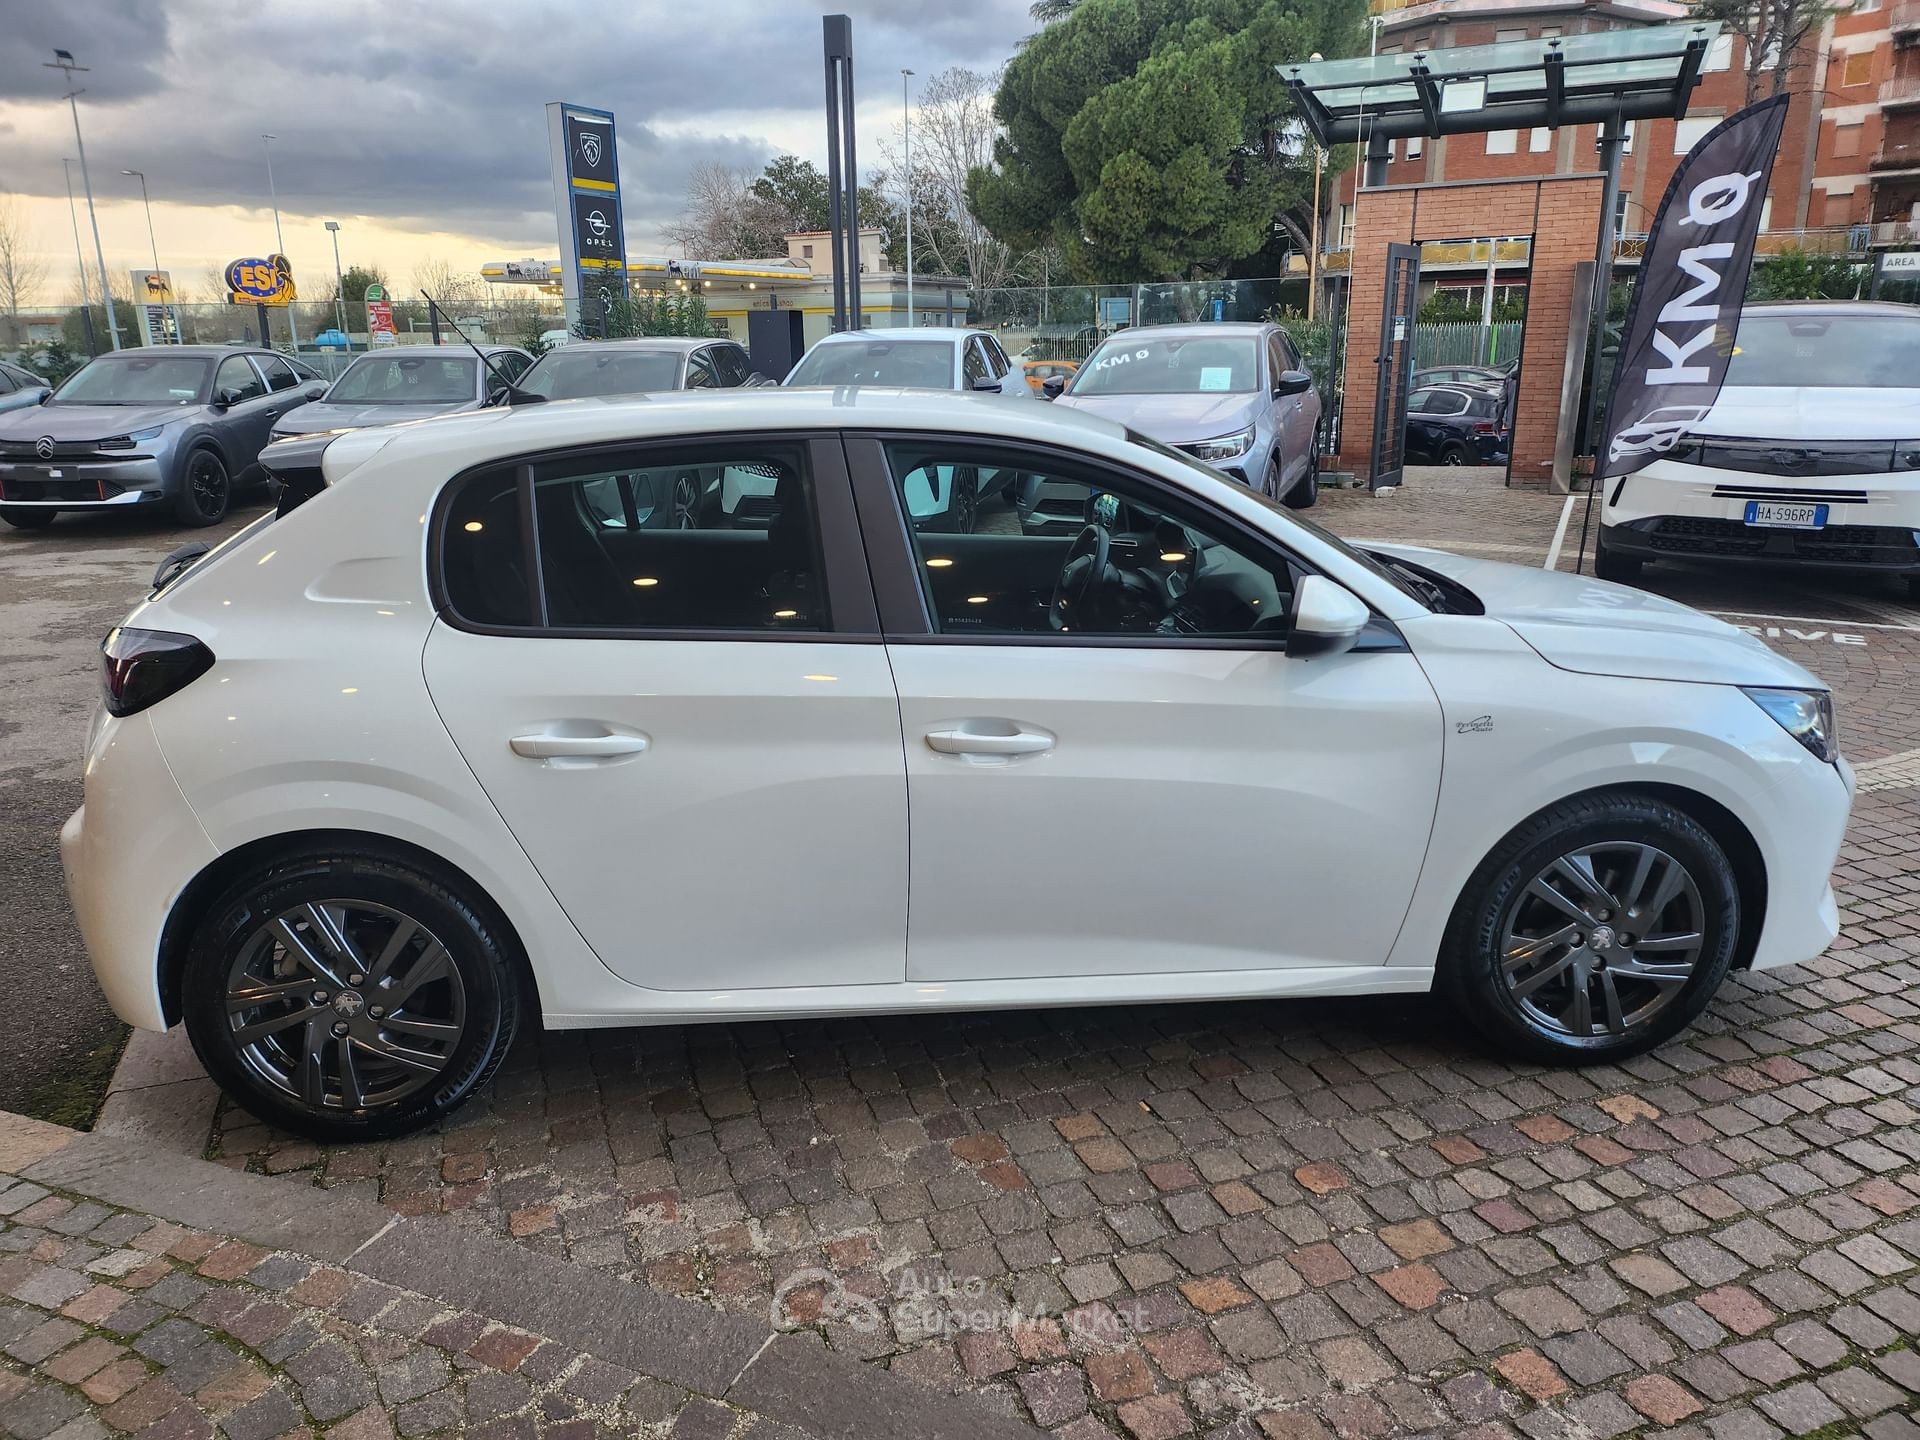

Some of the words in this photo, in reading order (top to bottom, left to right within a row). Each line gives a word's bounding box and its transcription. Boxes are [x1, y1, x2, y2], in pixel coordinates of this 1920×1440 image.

[586, 238, 613, 247] OPEL
[524, 261, 550, 279] eni
[1885, 257, 1915, 267] AREA
[240, 265, 277, 290] ESI
[1645, 243, 1735, 385] KM
[1096, 354, 1130, 371] KM
[1735, 624, 1867, 645] RIVE
[1480, 866, 1520, 949] MICHELIN
